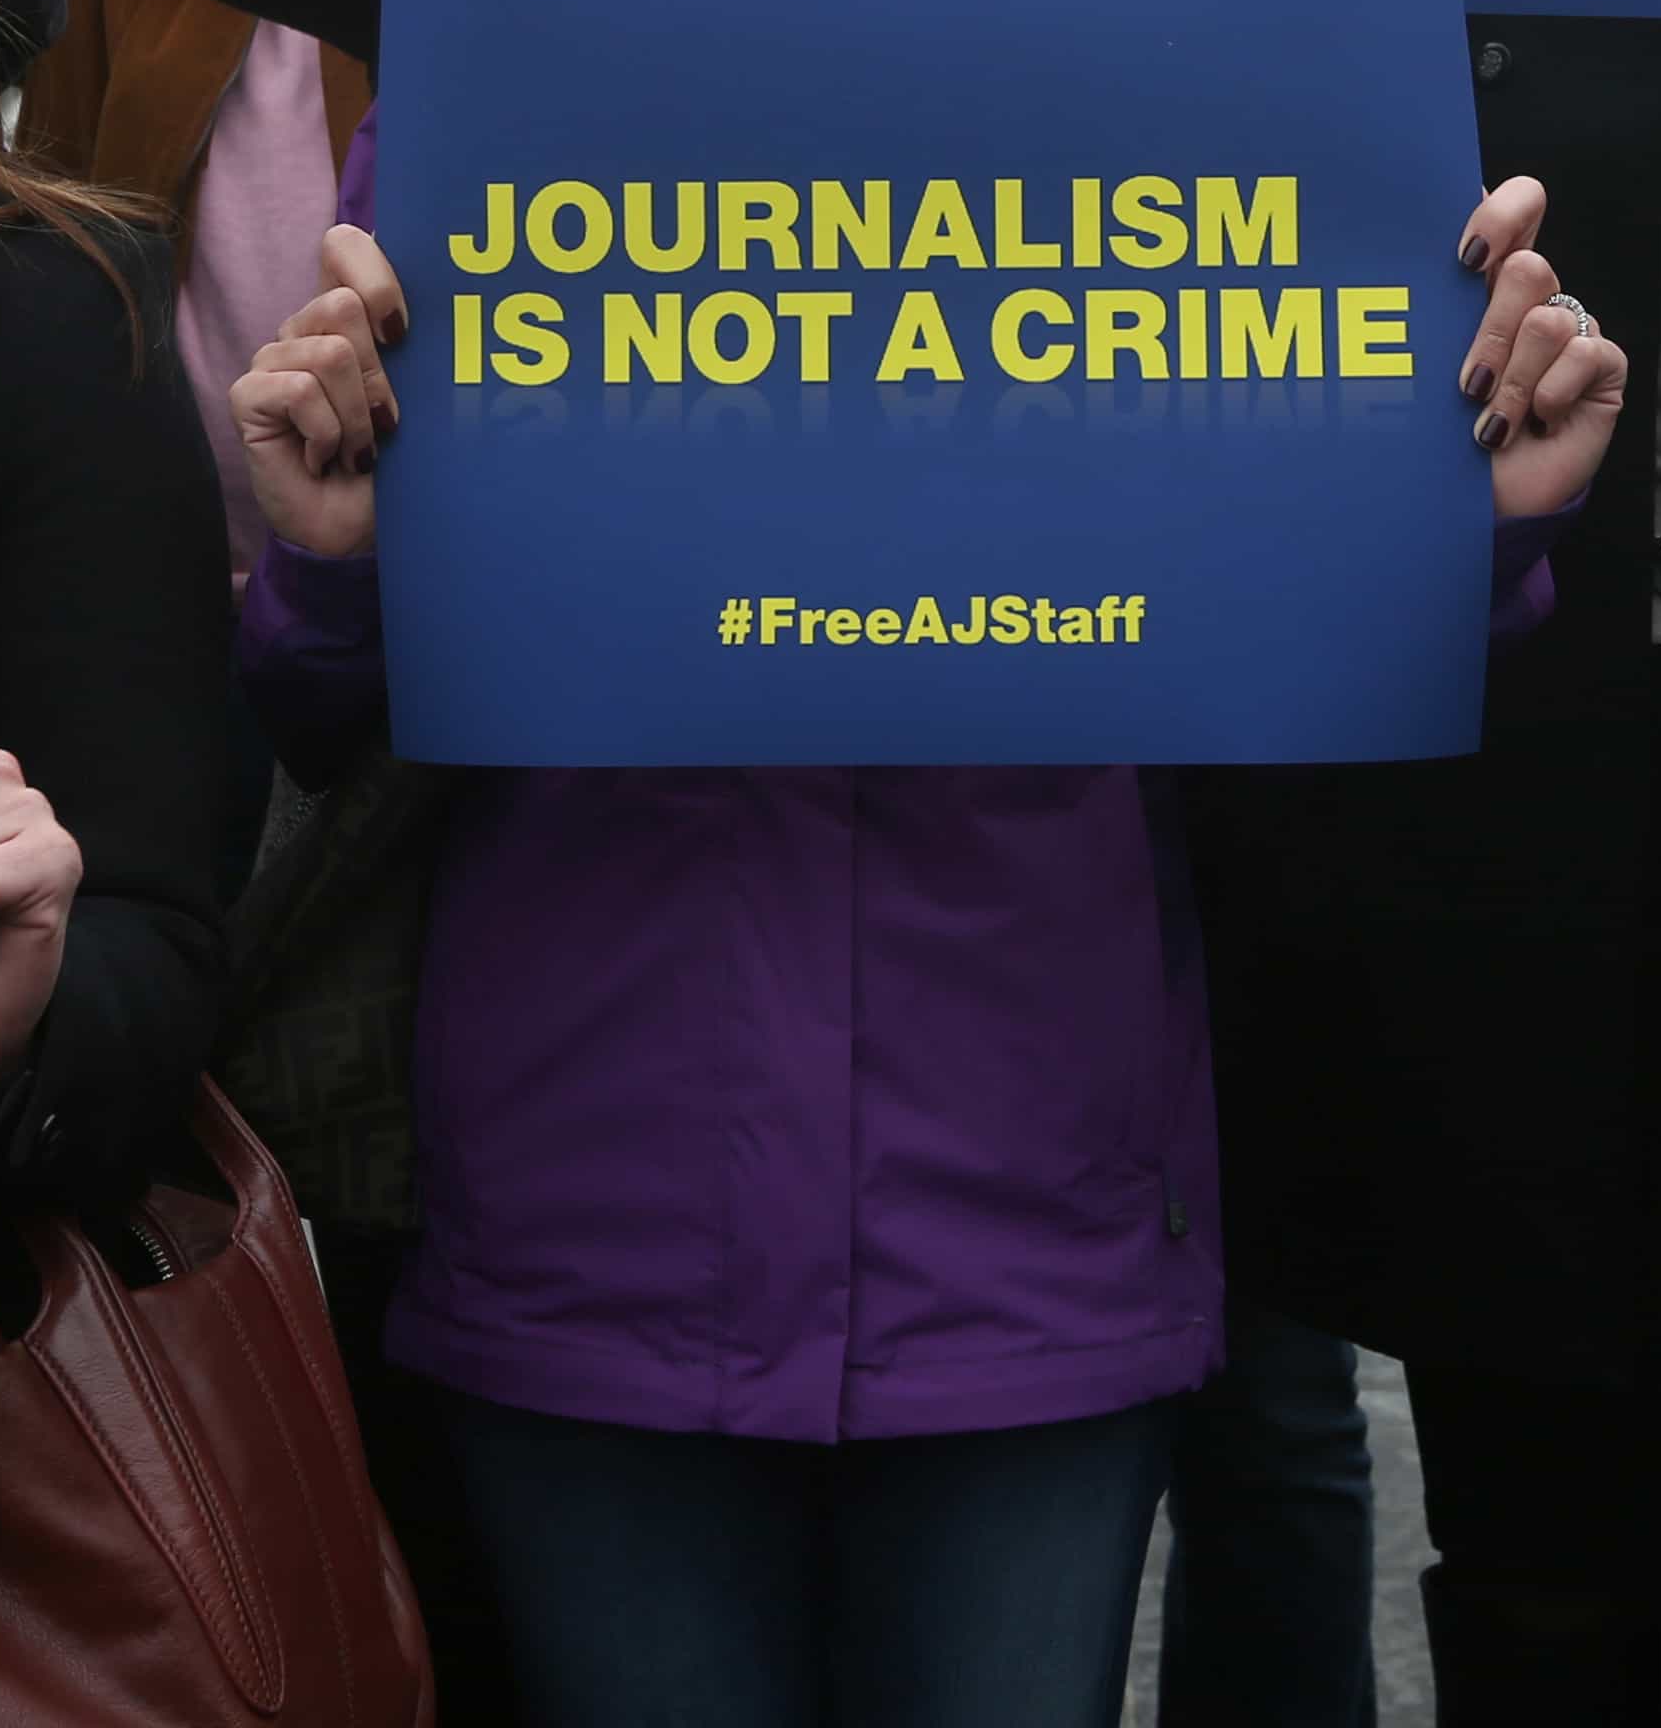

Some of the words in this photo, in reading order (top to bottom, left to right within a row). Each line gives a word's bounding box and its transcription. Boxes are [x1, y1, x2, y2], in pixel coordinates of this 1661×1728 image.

[449, 176, 1298, 274] JOURNALISM
[454, 292, 571, 385] IS
[604, 291, 853, 384] NOT
[877, 291, 964, 381] A
[992, 287, 1414, 382] CRIME
[719, 596, 1145, 644] #FreeAJStaff
